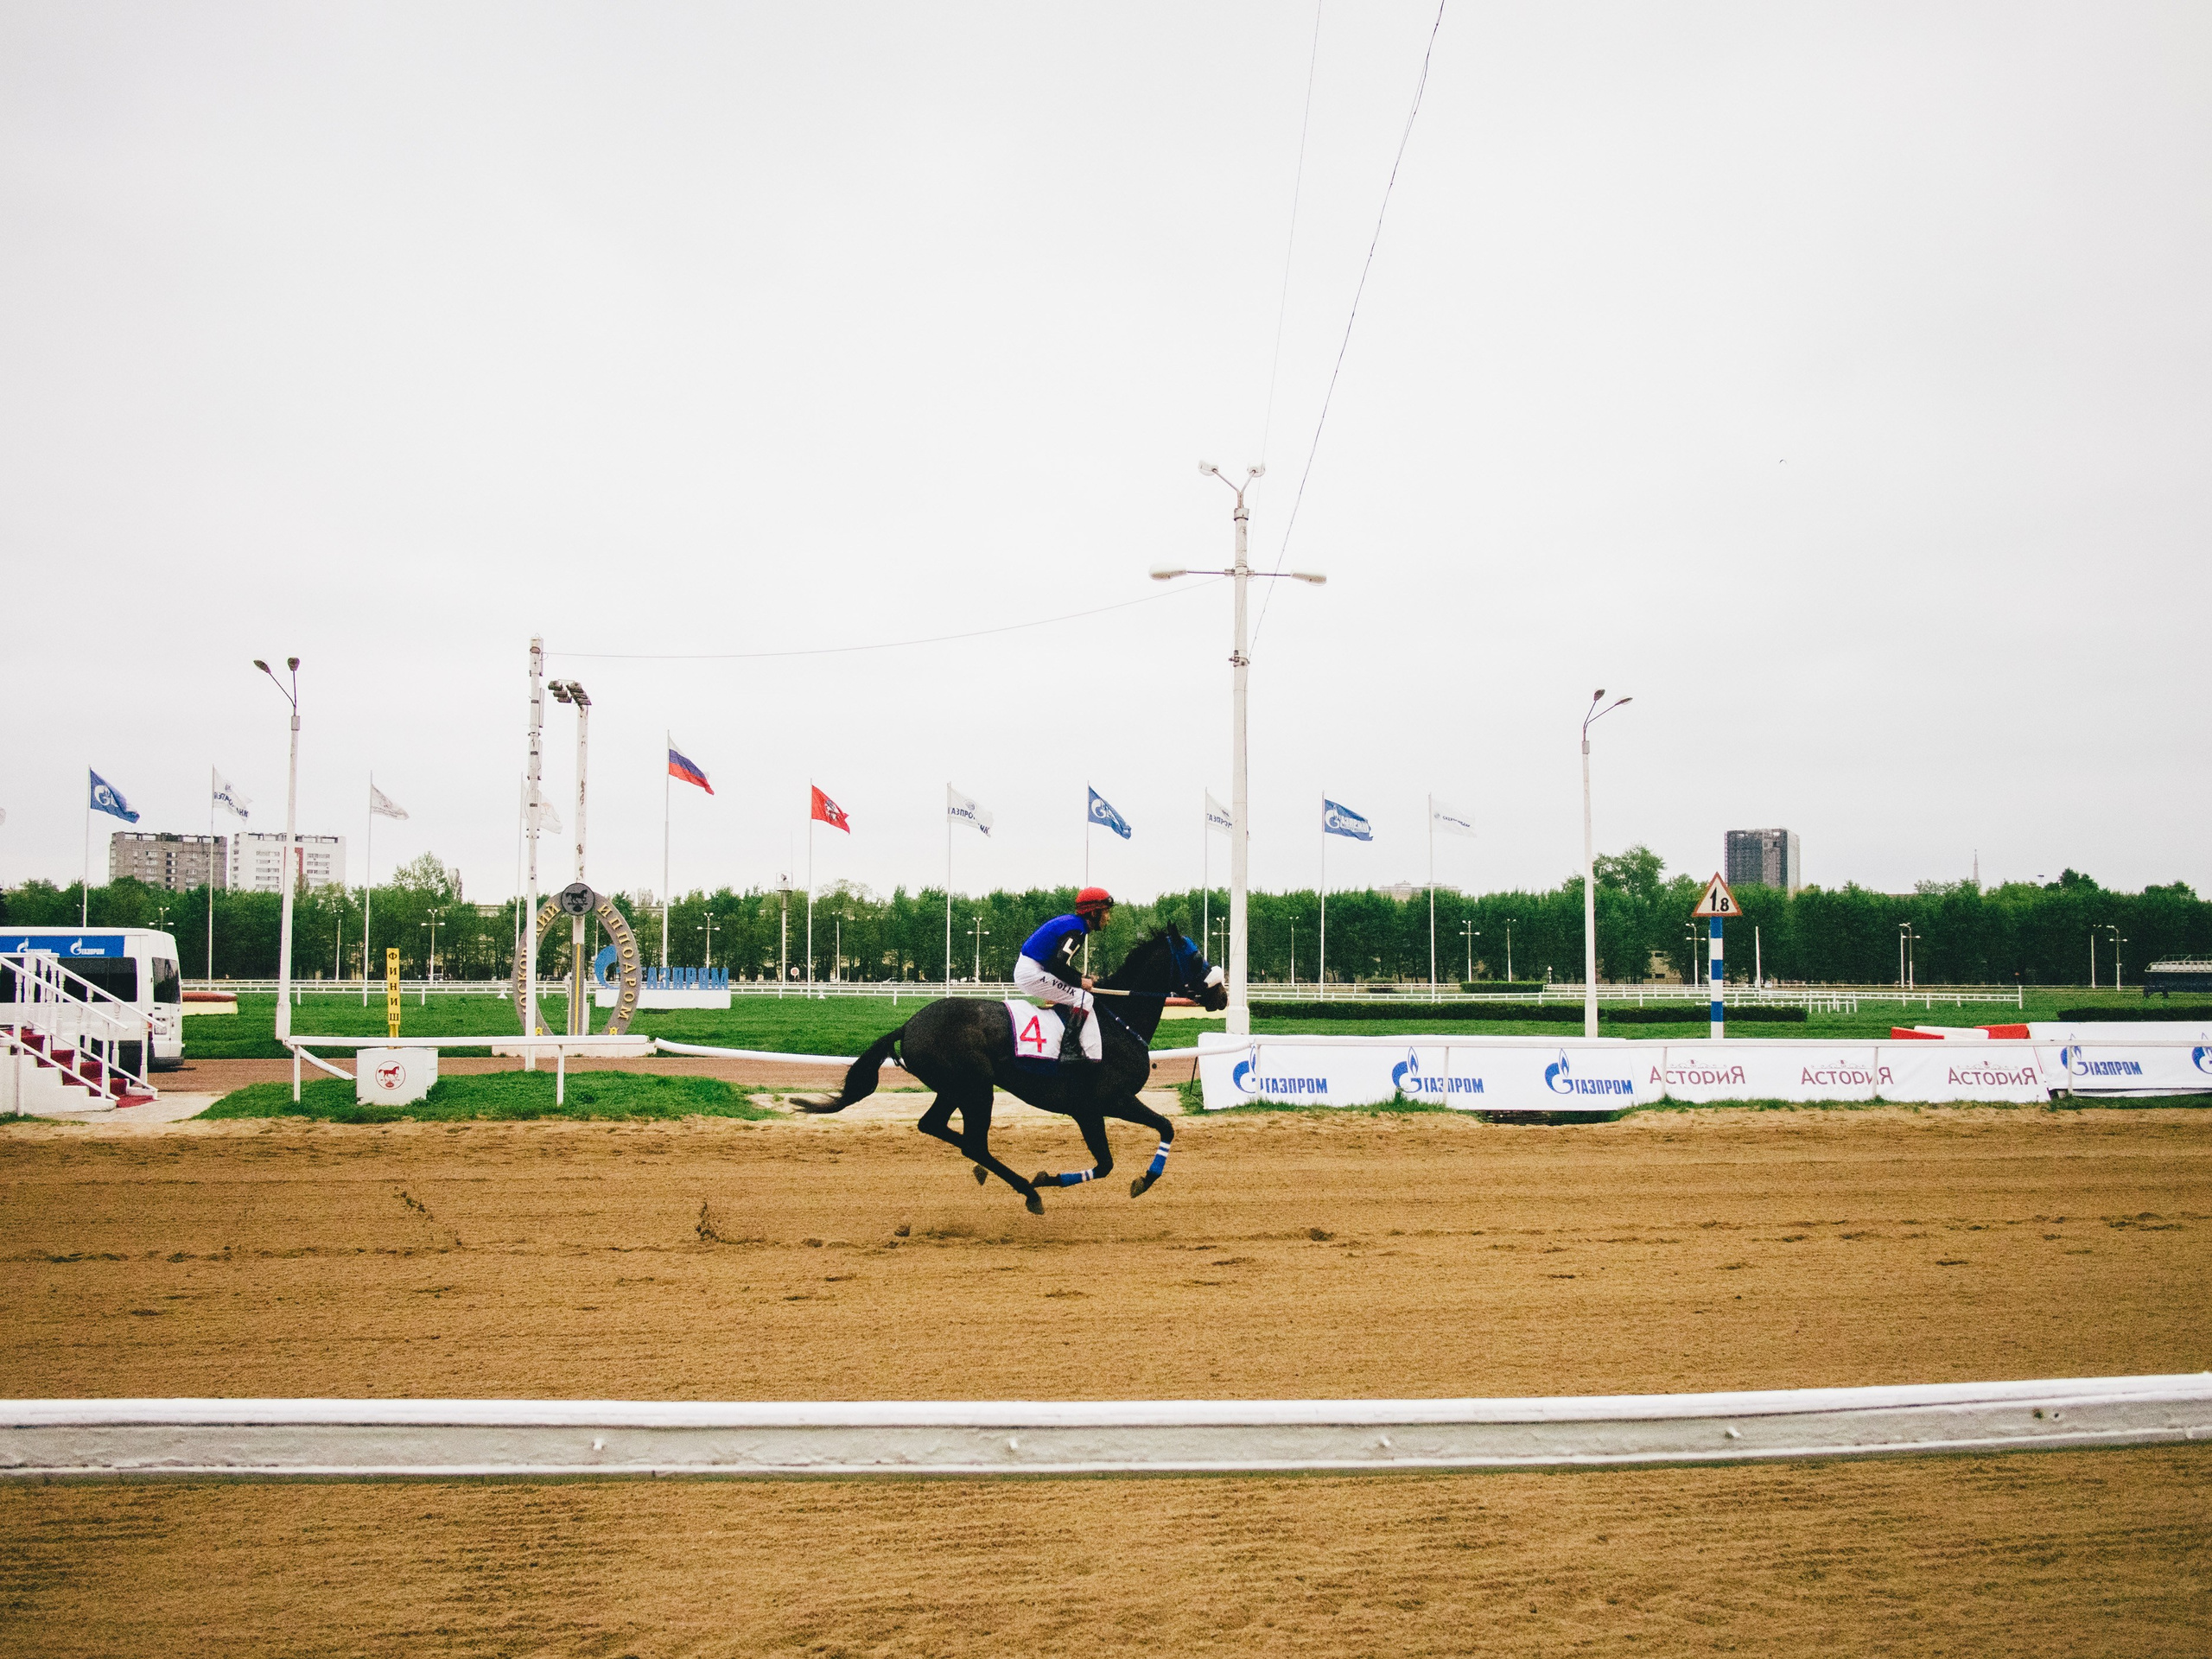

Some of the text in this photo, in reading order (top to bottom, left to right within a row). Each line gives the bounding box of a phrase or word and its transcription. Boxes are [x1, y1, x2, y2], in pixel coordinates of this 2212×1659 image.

[1710, 887, 1730, 912] 1.8
[596, 903, 637, 1020] ИППОДРОМ
[388, 951, 400, 1021] ФИНИШ
[1052, 978, 1077, 996] VOLIK
[1019, 1014, 1046, 1053] 4
[2088, 1061, 2143, 1076] ГАЗПРОМ
[1265, 1077, 1328, 1094] ГАЗПРОМ
[1424, 1077, 1484, 1093] ГАЗПРОМ
[1574, 1078, 1634, 1095] ГАЗПРОМ
